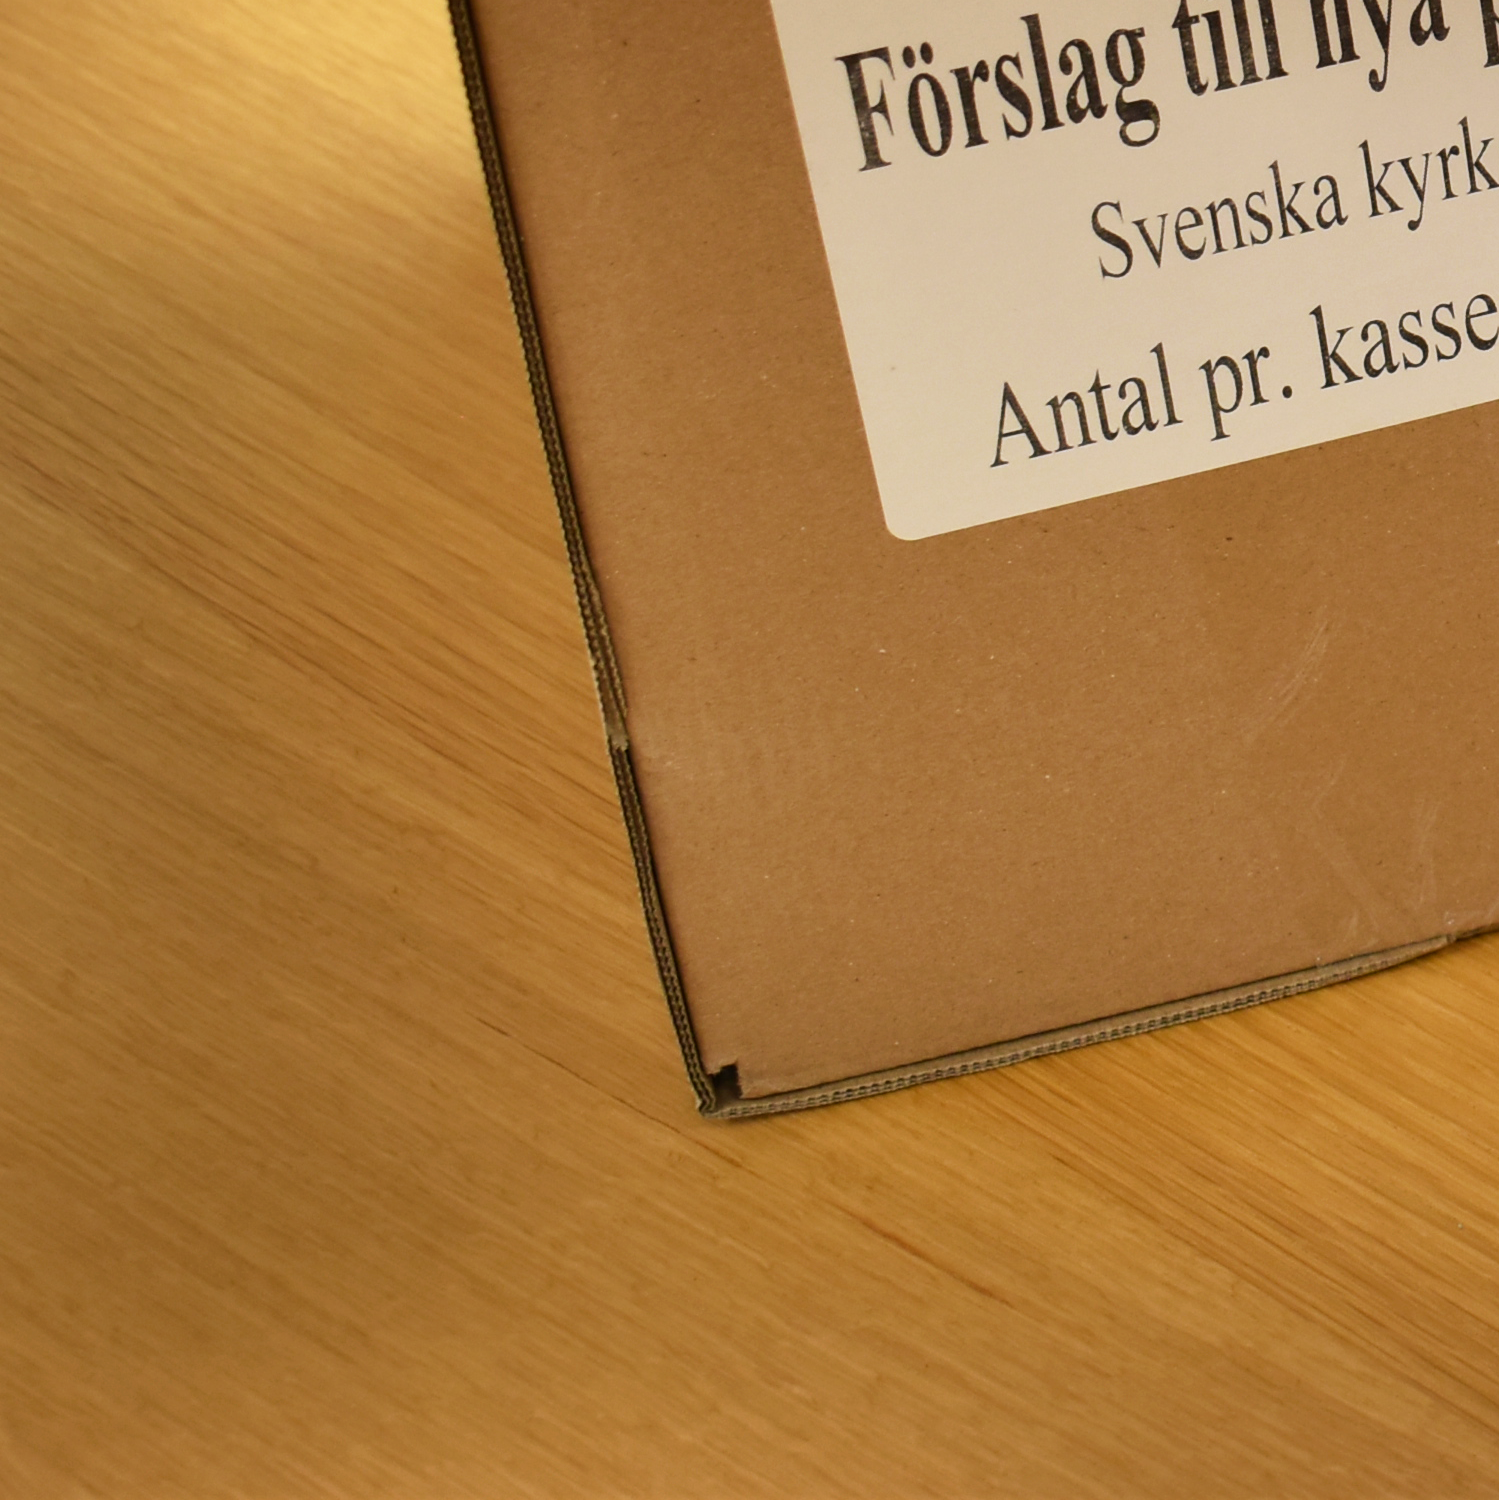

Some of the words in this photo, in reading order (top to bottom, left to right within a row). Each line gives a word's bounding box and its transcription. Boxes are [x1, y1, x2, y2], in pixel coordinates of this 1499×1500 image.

[834, 13, 1161, 172] Förslag
[1091, 160, 1348, 278] Svenska
[989, 342, 1183, 468] Antal
[1198, 346, 1293, 442] pr.
